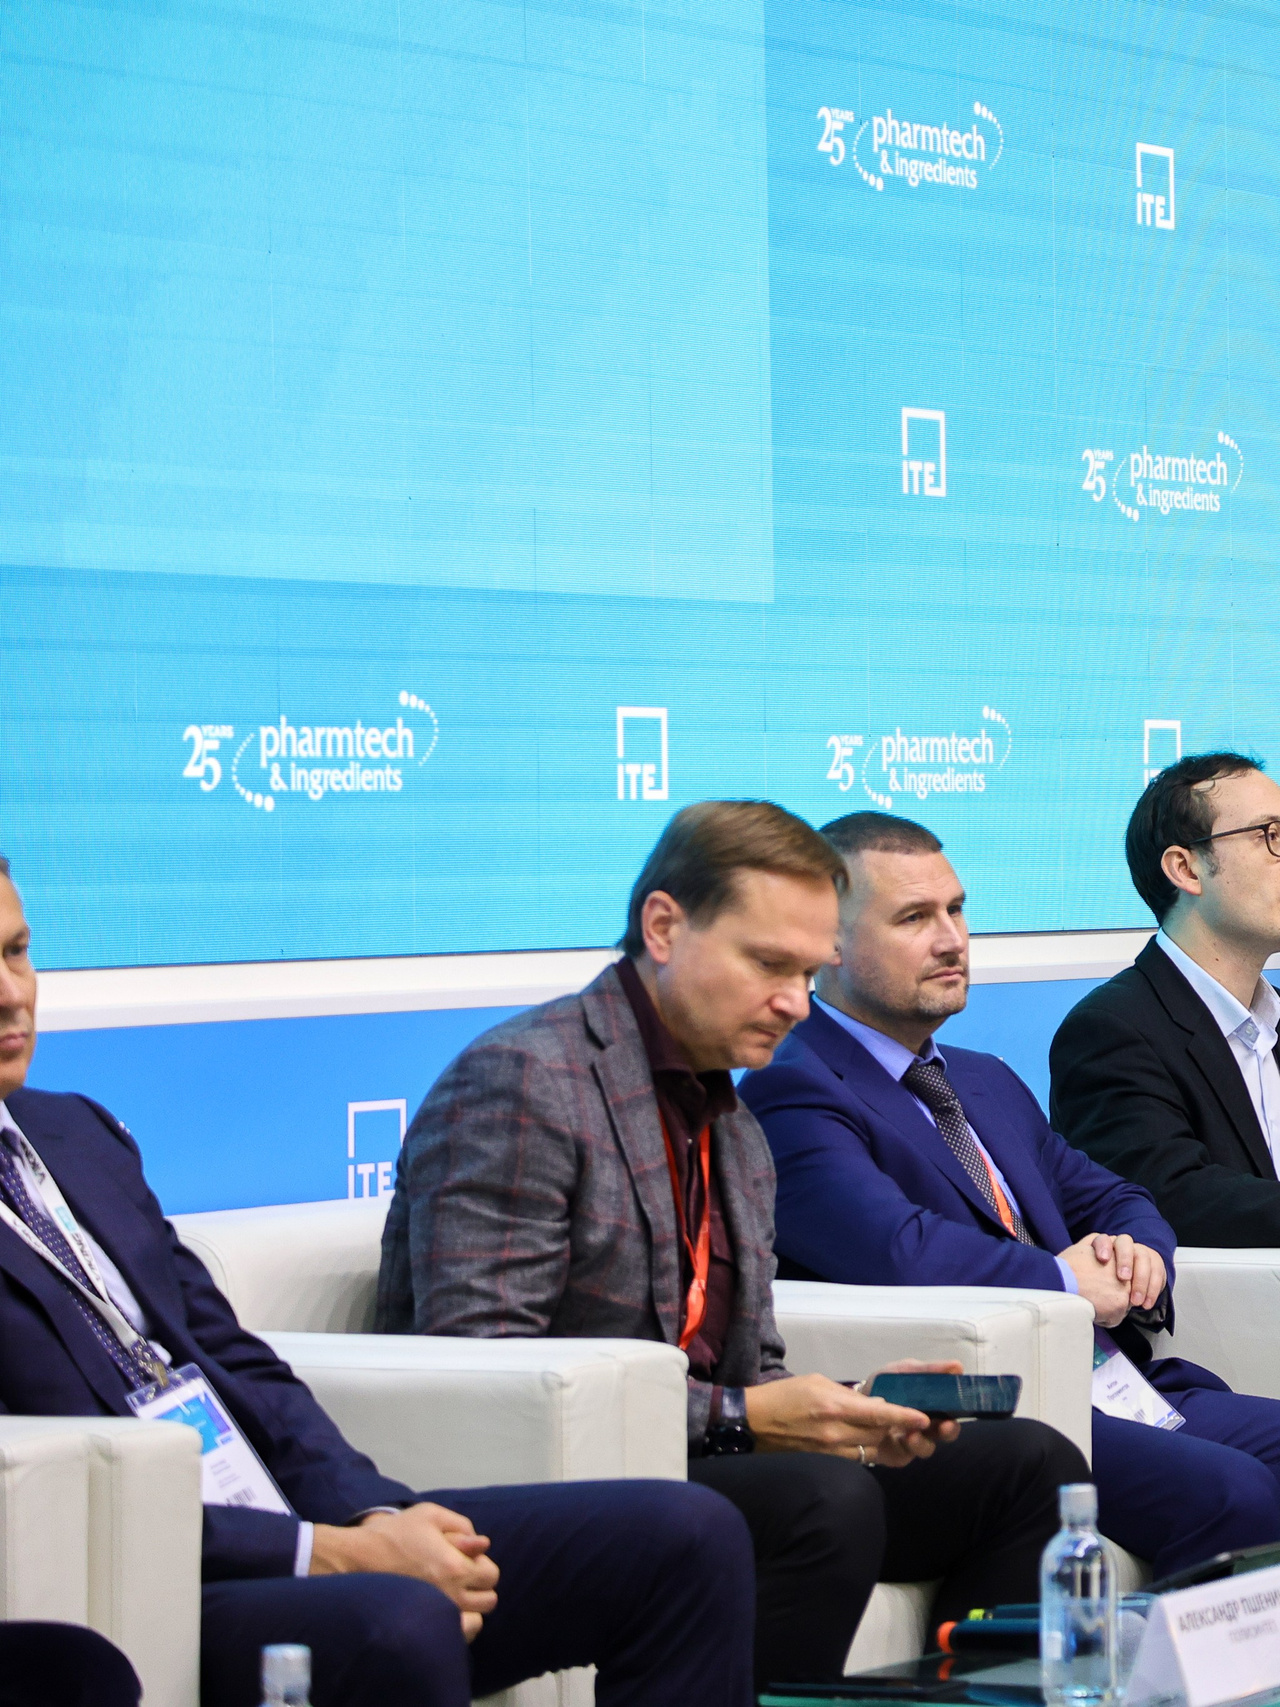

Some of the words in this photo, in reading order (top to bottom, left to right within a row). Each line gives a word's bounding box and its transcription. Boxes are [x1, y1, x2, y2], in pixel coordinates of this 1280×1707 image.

[817, 107, 845, 165] 25
[872, 108, 985, 161] pharmtech
[880, 150, 893, 174] &
[895, 151, 978, 189] ingredients
[1081, 449, 1106, 502] 25
[1130, 445, 1228, 486] pharmtech
[1136, 483, 1148, 506] &
[1149, 483, 1220, 515] ingredients
[201, 725, 234, 738] YEARS
[260, 714, 414, 768] pharmtech
[882, 726, 994, 771] pharmtech
[183, 725, 222, 792] 25
[826, 735, 854, 791] 25
[270, 762, 289, 791] &
[291, 761, 403, 801] ingredients
[889, 767, 902, 792] &
[903, 766, 986, 799] ingredients
[1178, 1604, 1241, 1632] АЛЕКСАНДР
